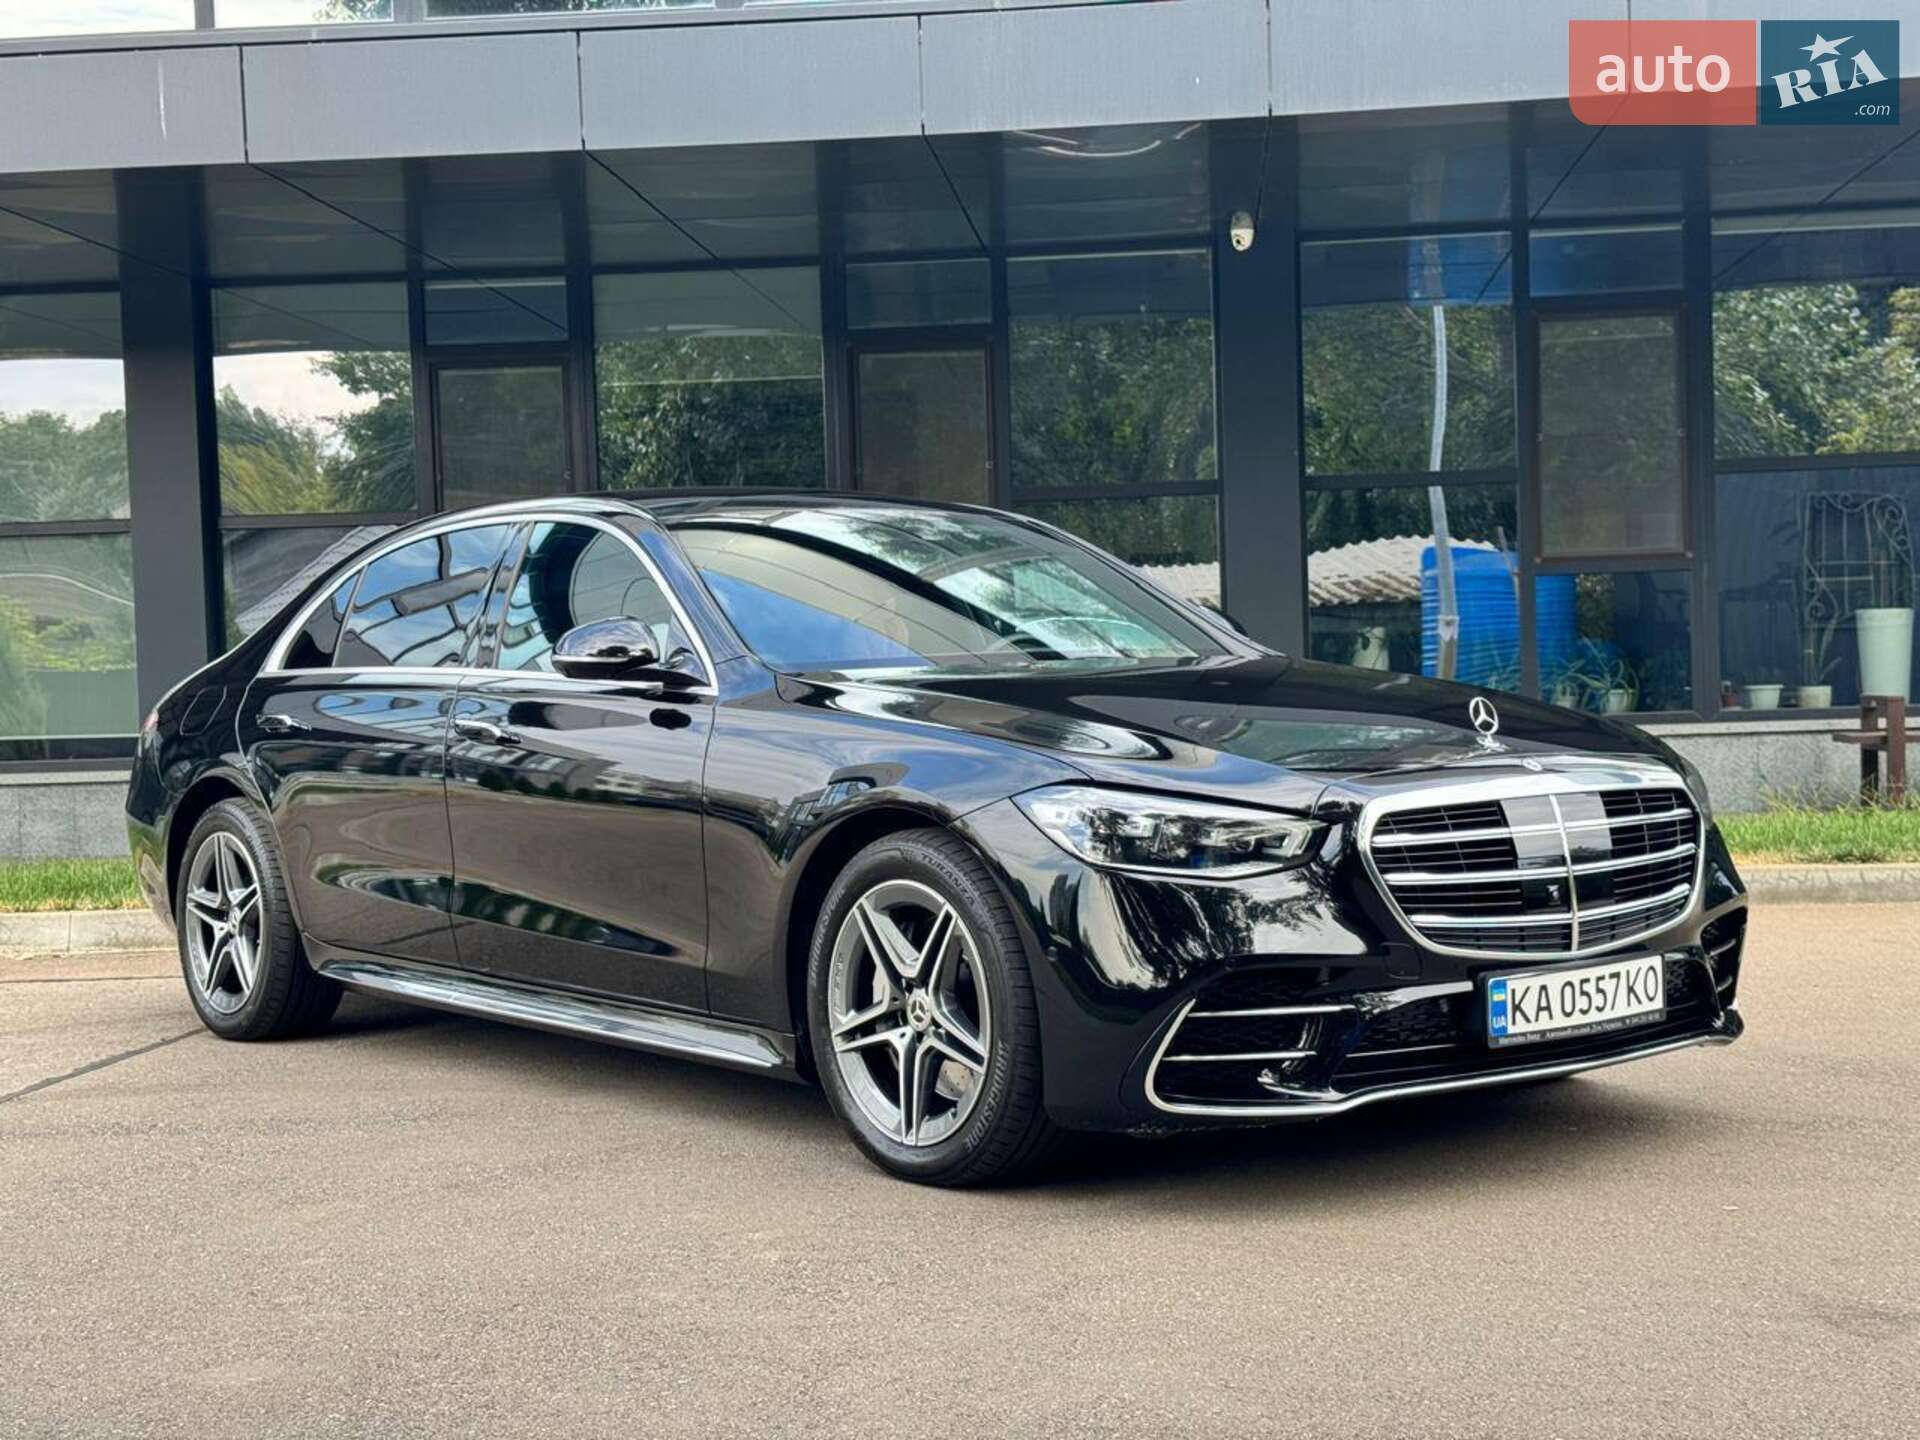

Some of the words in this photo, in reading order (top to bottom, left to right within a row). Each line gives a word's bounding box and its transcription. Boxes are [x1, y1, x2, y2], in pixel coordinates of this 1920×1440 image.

[920, 852, 975, 907] TURANZA
[1493, 1015, 1506, 1028] UA
[1511, 984, 1553, 1026] KA
[1560, 971, 1621, 1018] 0557
[1626, 965, 1659, 1007] KO
